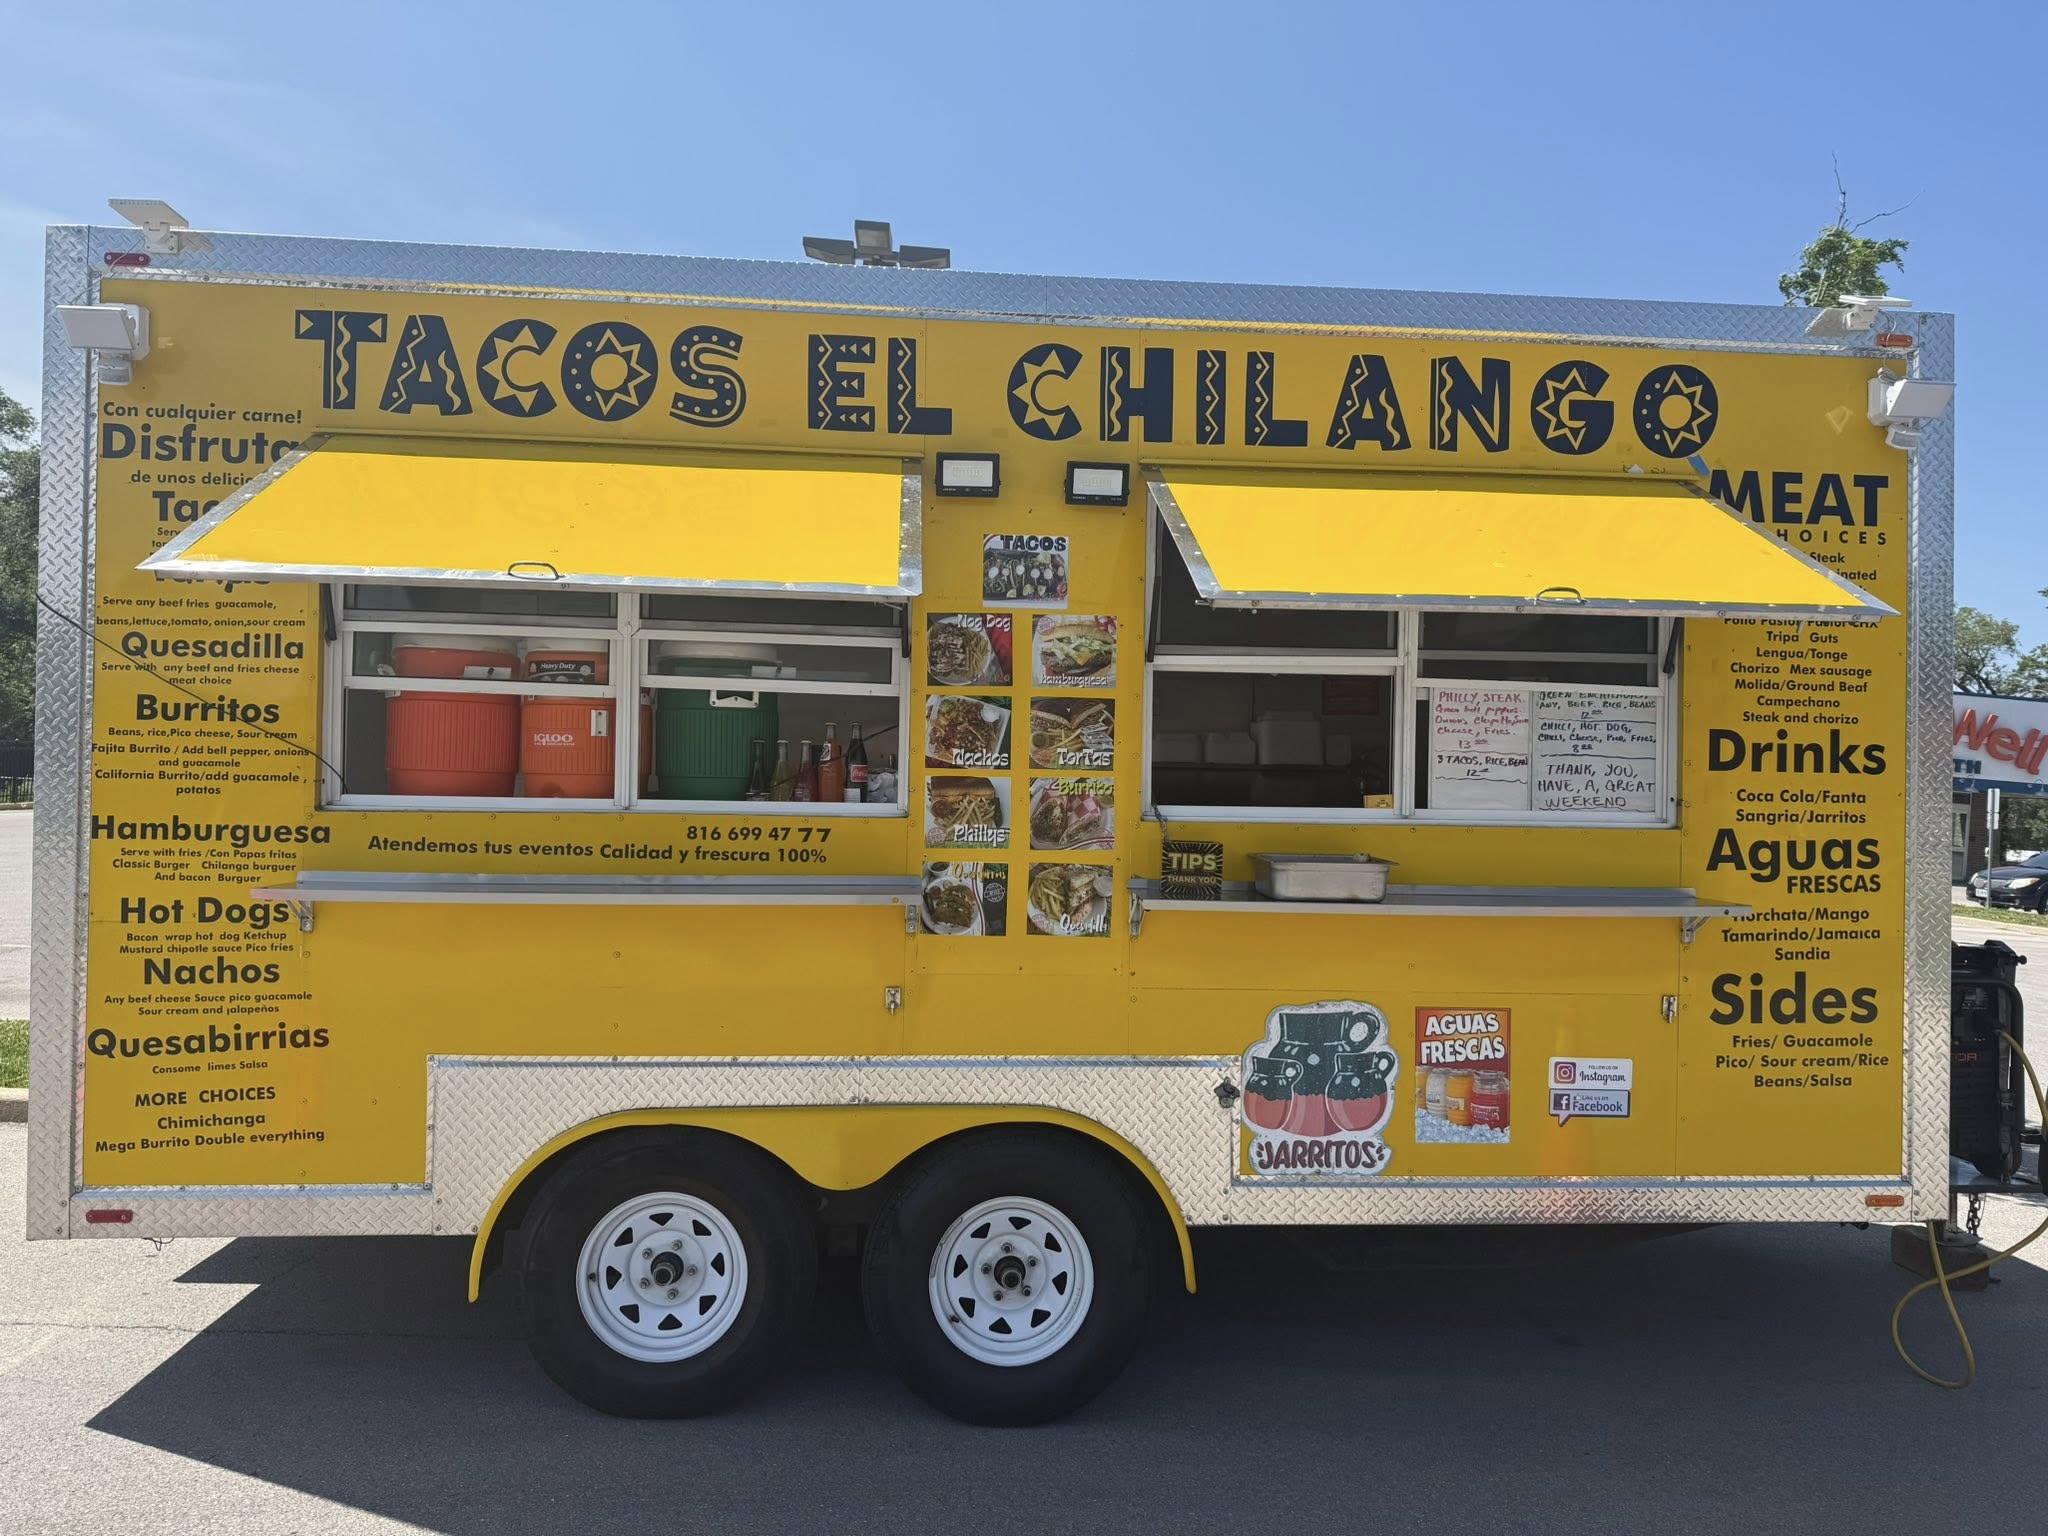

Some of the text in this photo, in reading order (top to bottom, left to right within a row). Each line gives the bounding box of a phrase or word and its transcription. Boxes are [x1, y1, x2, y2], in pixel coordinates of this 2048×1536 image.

[295, 310, 1719, 459] TACOS EL CHILANGO
[103, 402, 301, 424] Con cualquier carne!
[131, 470, 196, 484] de unos
[1709, 469, 1888, 526] MEAT
[1000, 535, 1066, 551] TACOS
[1776, 529, 1886, 545] HOICES
[1809, 552, 1845, 564] Steak
[103, 596, 276, 610] Serve any beef fries guacamole,
[986, 615, 1010, 631] Dog
[1766, 631, 1838, 644] Tripa Guts
[121, 632, 304, 659] Quesadilla
[1756, 647, 1848, 662] Lengua/Tonge
[102, 662, 299, 674] Serve any beef and fries cheese
[1730, 662, 1872, 679] Chorizo Mex sausage
[200, 676, 232, 684] choice
[1735, 679, 1868, 692] Molida/Ground Beaf
[136, 694, 280, 724] Burritos
[1757, 695, 1840, 709] Campechano
[1743, 711, 1859, 724] Steak and chorizo
[109, 727, 261, 739] Beans, cheese, Sour
[534, 734, 573, 745] IGLOO
[91, 743, 270, 757] Fajita Burrito Add bell pepper,
[952, 748, 1009, 766] Nachos
[1709, 729, 1886, 775] Drinks
[159, 758, 240, 768] and guacamole
[95, 769, 229, 781] California Burrito/add
[176, 786, 221, 796] potatos
[1737, 789, 1866, 804] Coca Cola/Fanta
[1546, 797, 1626, 808] WEEKEND
[1736, 809, 1866, 825] Sangria/Jarritos
[92, 814, 330, 848] Hamburguesa
[687, 826, 831, 842] 816 699 47 77
[121, 848, 296, 860] Serve with fries Papas fritas
[368, 836, 826, 863] Atendemos tus eventos Calidad y frescura 100%
[1706, 828, 1880, 882] Aguas
[113, 858, 296, 872] Classic Burger Chilanga burguer
[1168, 852, 1217, 870] TIPS
[154, 872, 261, 884] And bacon Burguer
[1168, 875, 1216, 884] THANK YOU
[1787, 874, 1881, 894] FRESCAS
[121, 897, 290, 930] Hot Dogs
[127, 933, 158, 941] Bacon
[196, 932, 213, 940] hot
[220, 931, 240, 942] dog
[244, 931, 286, 941] Ketchup
[1721, 927, 1880, 942] Tamarindo/Jamaica
[120, 945, 163, 953] Mustard
[167, 944, 208, 955] chipotle
[246, 943, 267, 952] Pico
[270, 943, 294, 951] fries
[1775, 947, 1830, 961] Sandia
[144, 956, 280, 984] Nachos
[105, 991, 312, 1005] Any beef cheese Sauce pico guacamole
[1710, 971, 1878, 1025] Sides
[138, 1007, 163, 1015] Sour
[202, 1005, 223, 1014] and
[1425, 1013, 1499, 1036] AGUAS
[88, 1022, 329, 1059] Quesabirrias
[1733, 1033, 1873, 1049] Fries/ Guacamole
[1421, 1037, 1505, 1064] FRESCAS
[152, 1060, 268, 1074] Consome limes Salsa
[1716, 1053, 1889, 1069] Pico/ Sour cream/Rice
[1579, 1071, 1626, 1085] Instagram
[1754, 1074, 1852, 1088] Beans/Salsa
[135, 1087, 275, 1107] MORE CHOICES
[1572, 1101, 1623, 1112] Facebook
[158, 1114, 265, 1129] Chimichanga
[96, 1129, 325, 1153] Mega Burrito Double everything
[1260, 1140, 1377, 1169] JARRITOS
